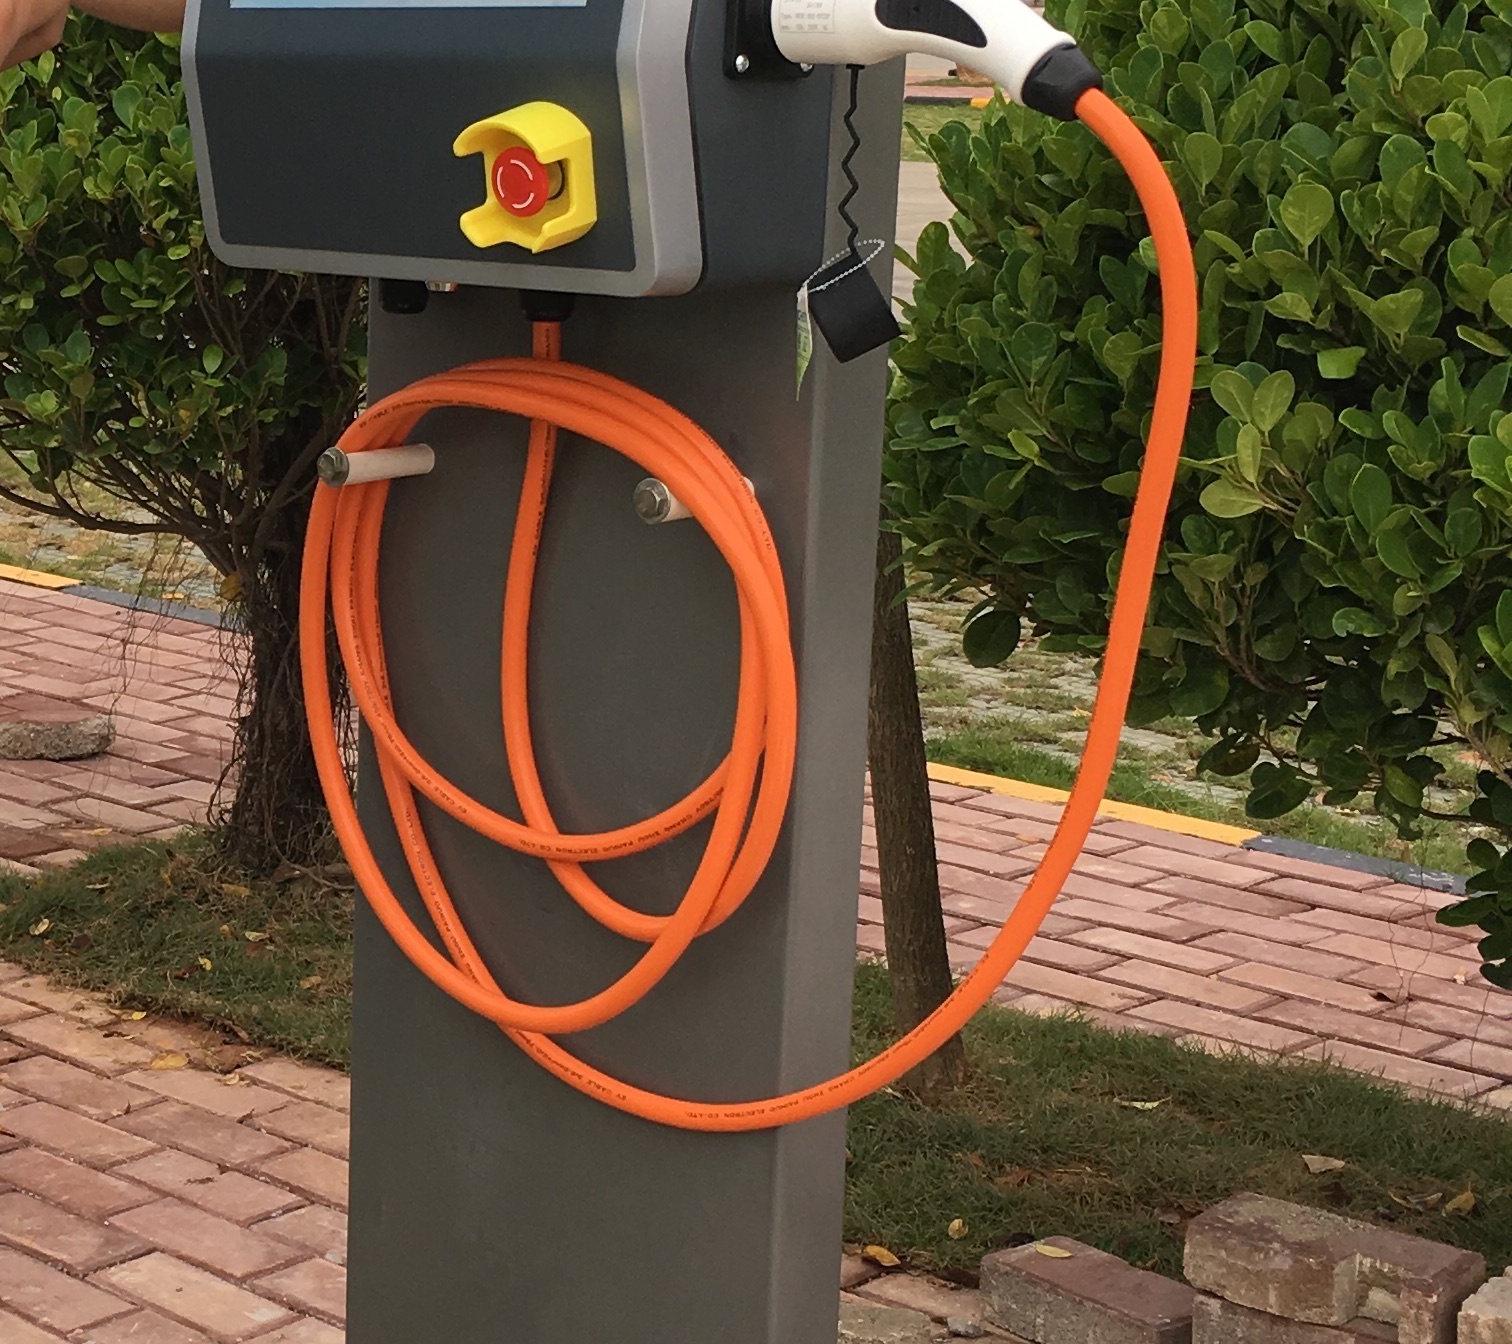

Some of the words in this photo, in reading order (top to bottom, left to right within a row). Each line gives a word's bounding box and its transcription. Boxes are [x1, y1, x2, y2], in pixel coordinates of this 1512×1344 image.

[434, 786, 456, 805] CABLE
[664, 813, 693, 833] CHANG
[638, 830, 661, 843] ZHOU
[555, 847, 598, 855] ELECTRON
[603, 840, 634, 853] PAINUO
[435, 901, 452, 933] PAINUO
[450, 935, 466, 959] ZHOU
[586, 1079, 614, 1095] CABLE
[769, 1099, 799, 1113] PAINUO
[724, 1109, 766, 1119] ELECTRON
